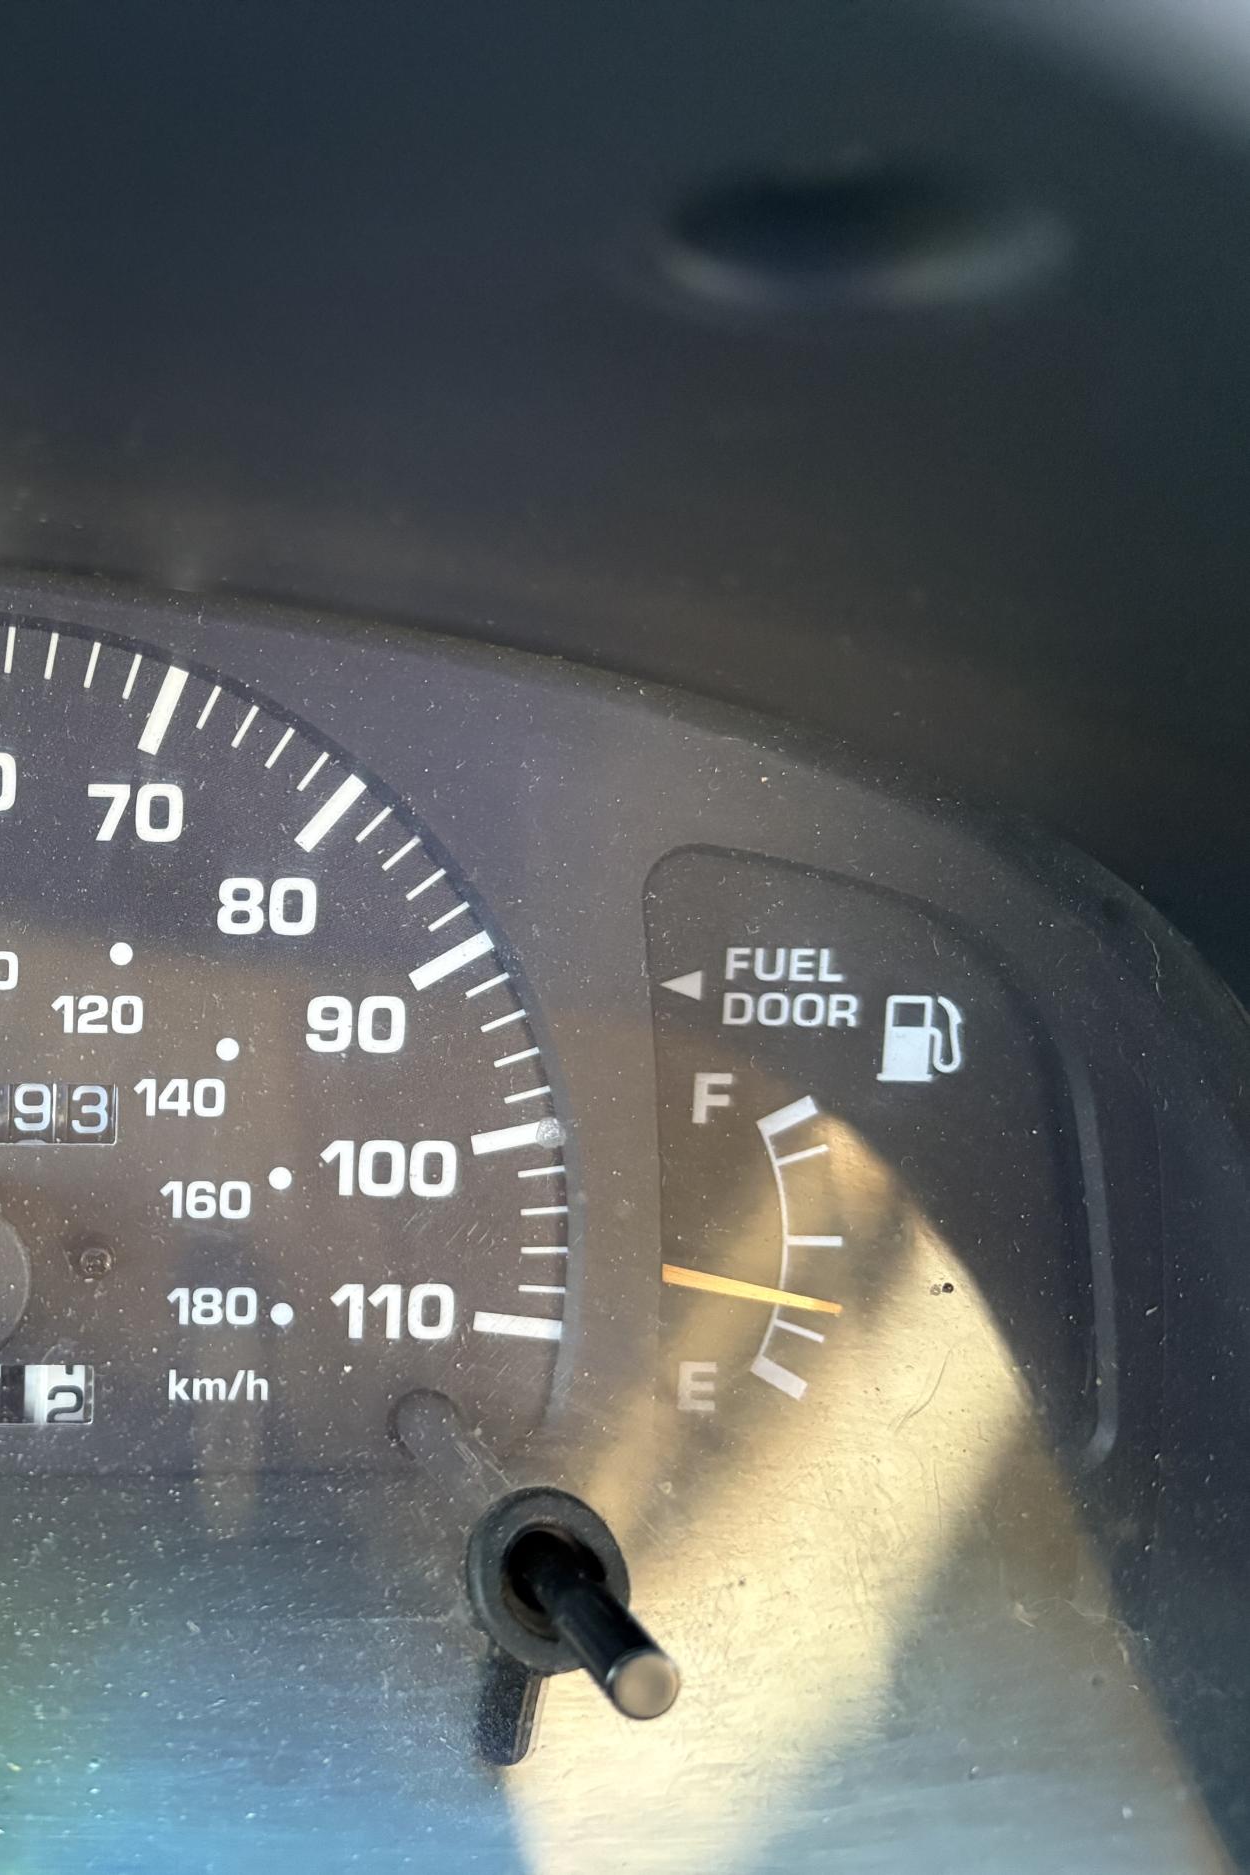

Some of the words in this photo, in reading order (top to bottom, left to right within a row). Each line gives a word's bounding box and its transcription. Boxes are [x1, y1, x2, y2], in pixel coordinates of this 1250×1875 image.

[87, 783, 184, 842] 70
[217, 877, 317, 936] 80
[725, 947, 843, 982] FUEL
[51, 995, 144, 1034] 120
[305, 995, 406, 1054] 90
[722, 992, 858, 1027] DOOR
[134, 1078, 226, 1117] 140
[692, 1072, 734, 1124] F
[319, 1139, 457, 1198] 100
[160, 1181, 251, 1220] 160
[167, 1287, 258, 1326] 180
[330, 1283, 455, 1340] 110
[168, 1369, 269, 1401] km/h
[678, 1361, 718, 1412] E
